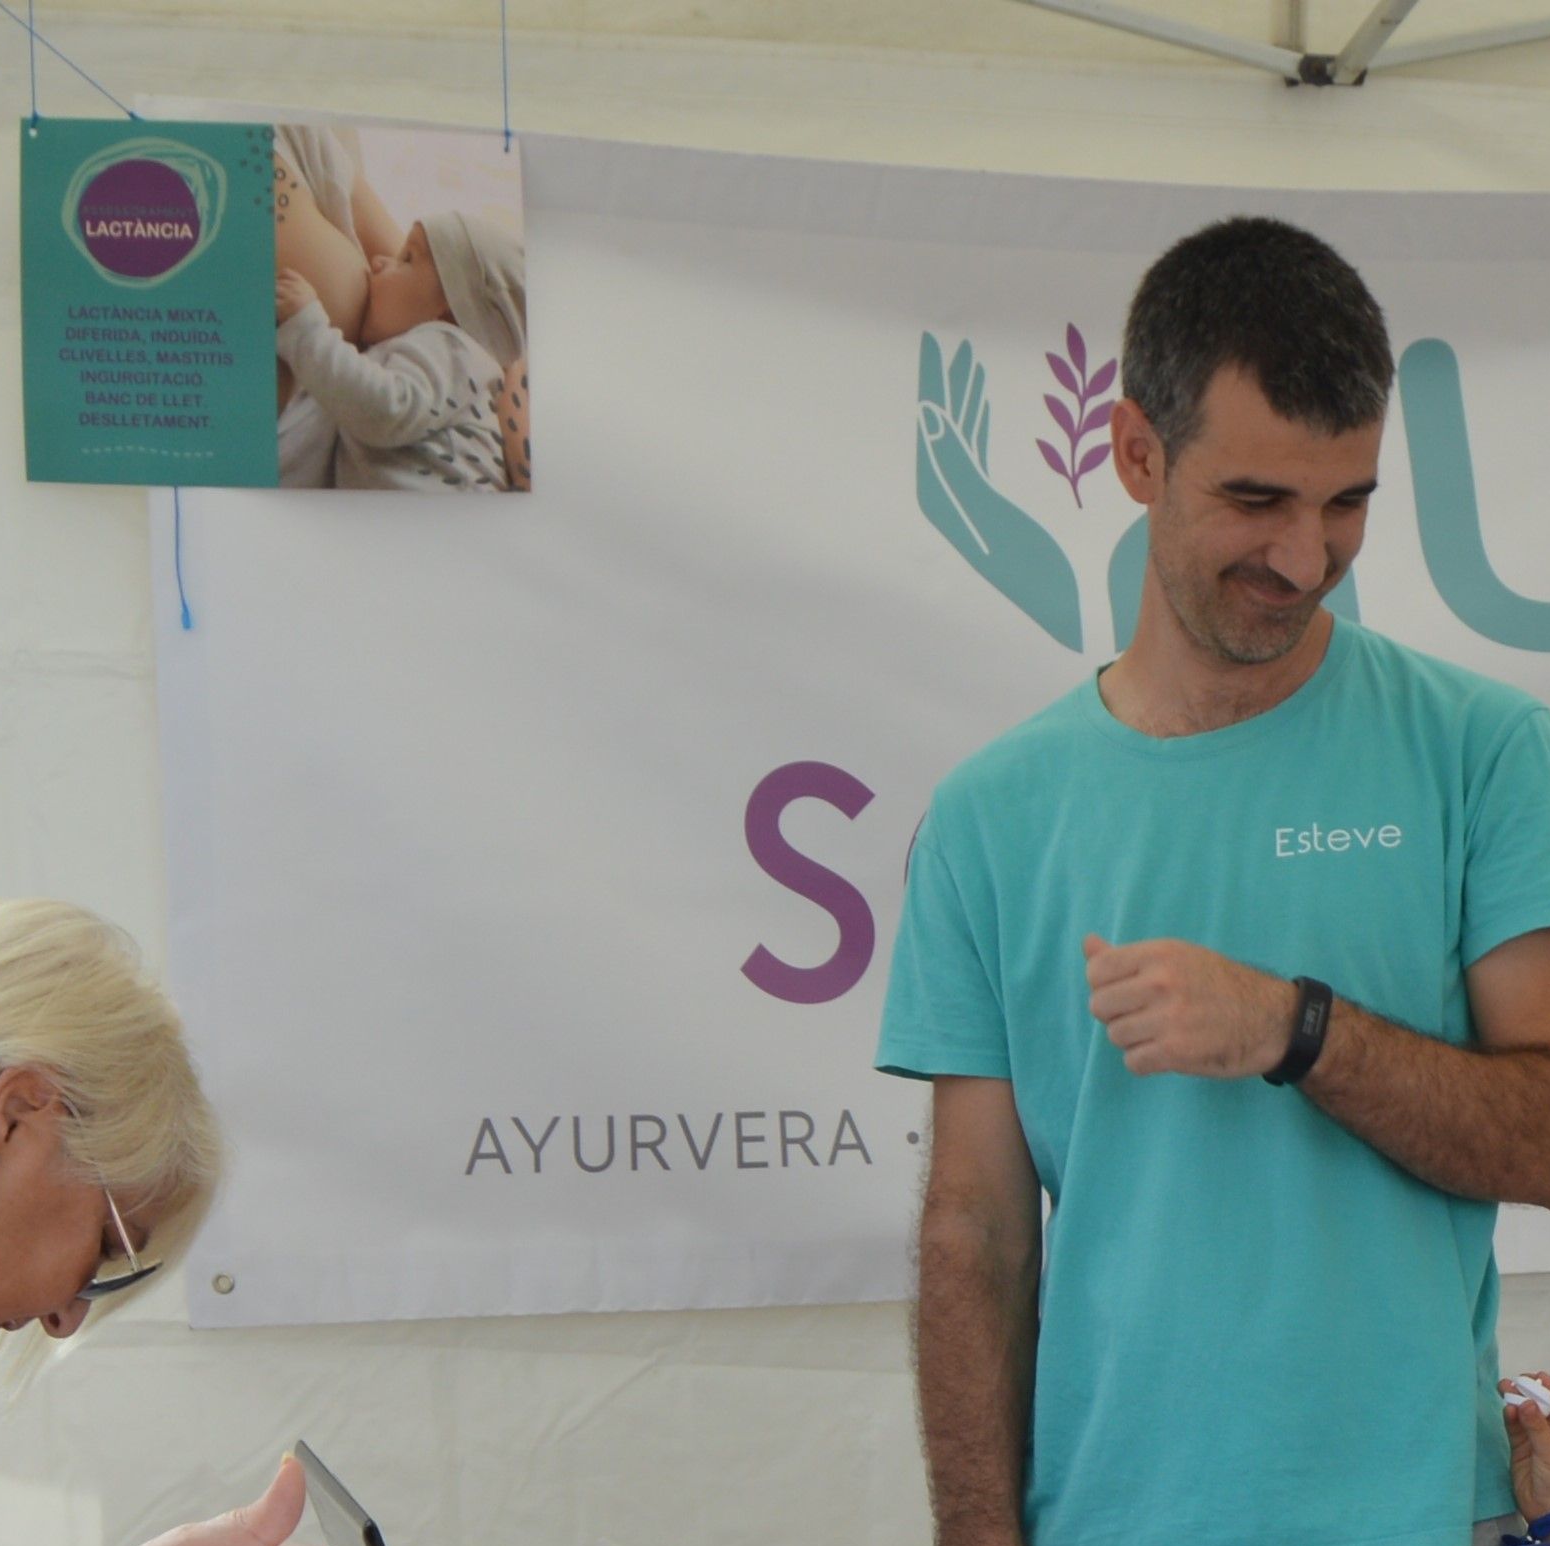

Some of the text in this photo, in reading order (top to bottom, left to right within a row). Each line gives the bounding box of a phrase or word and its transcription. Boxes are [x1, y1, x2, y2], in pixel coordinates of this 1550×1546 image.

[85, 217, 194, 240] LACTÀNCIA
[1274, 821, 1403, 859] Esteve
[464, 1108, 873, 1176] AYURVERA
